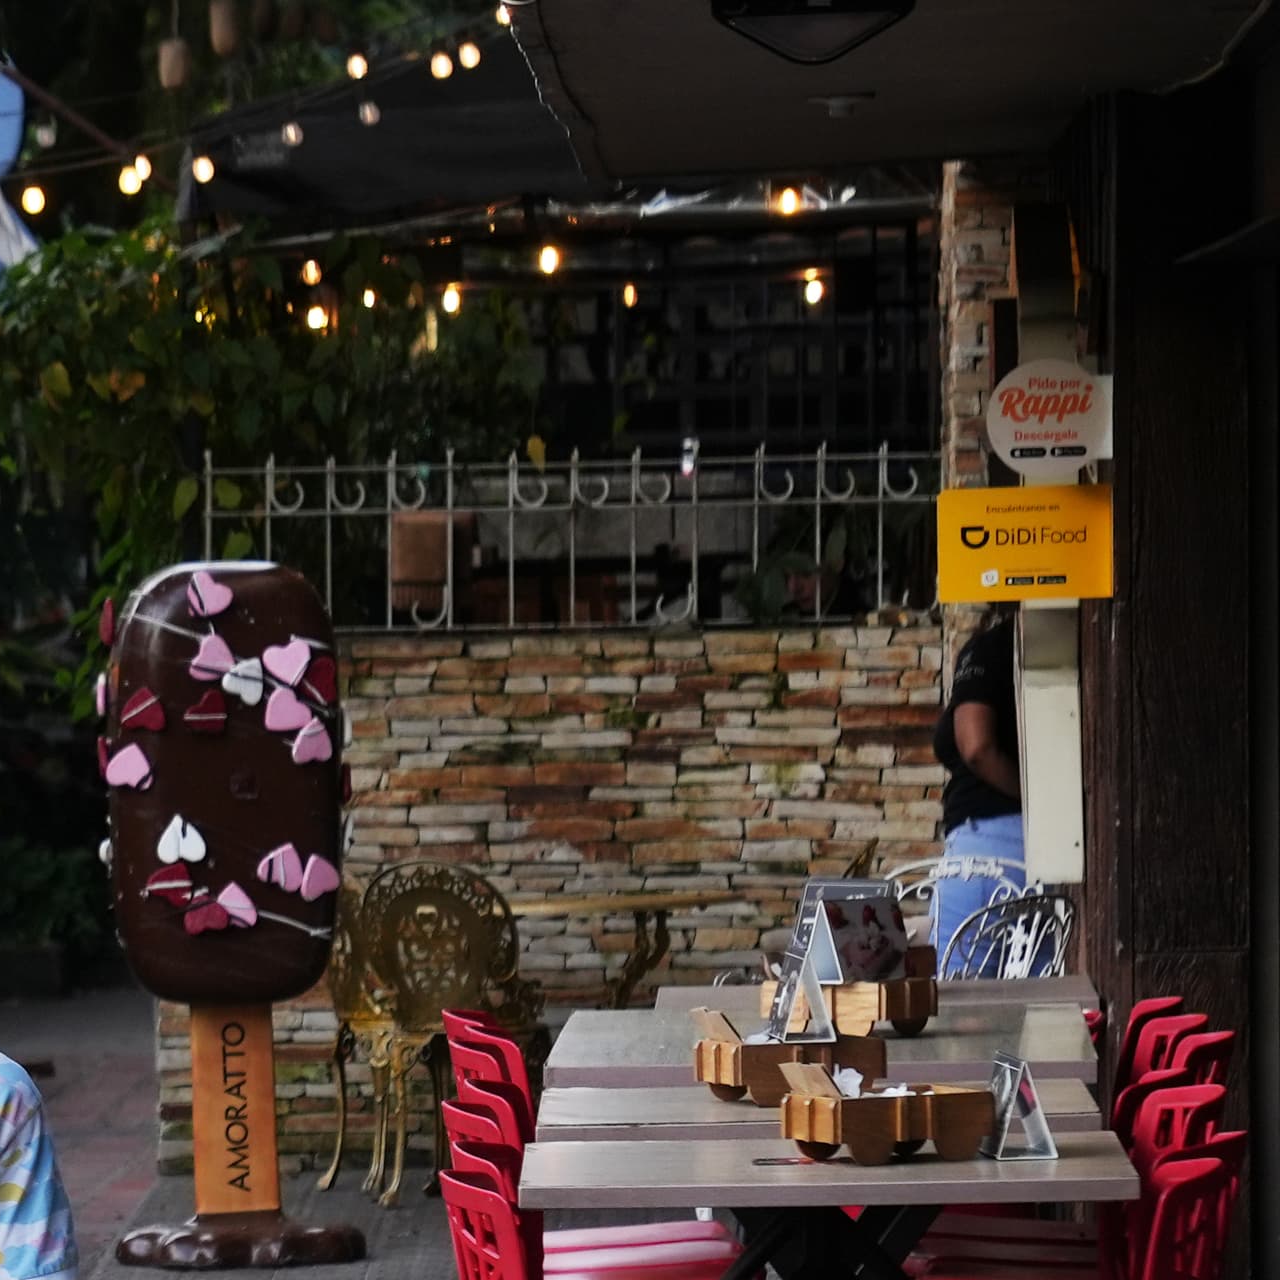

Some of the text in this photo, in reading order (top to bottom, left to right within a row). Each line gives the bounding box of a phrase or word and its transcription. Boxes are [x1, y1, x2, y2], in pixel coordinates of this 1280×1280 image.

[998, 384, 1094, 424] Rappi
[995, 524, 1088, 546] DiDi Food
[220, 1022, 252, 1193] AMORATTO
